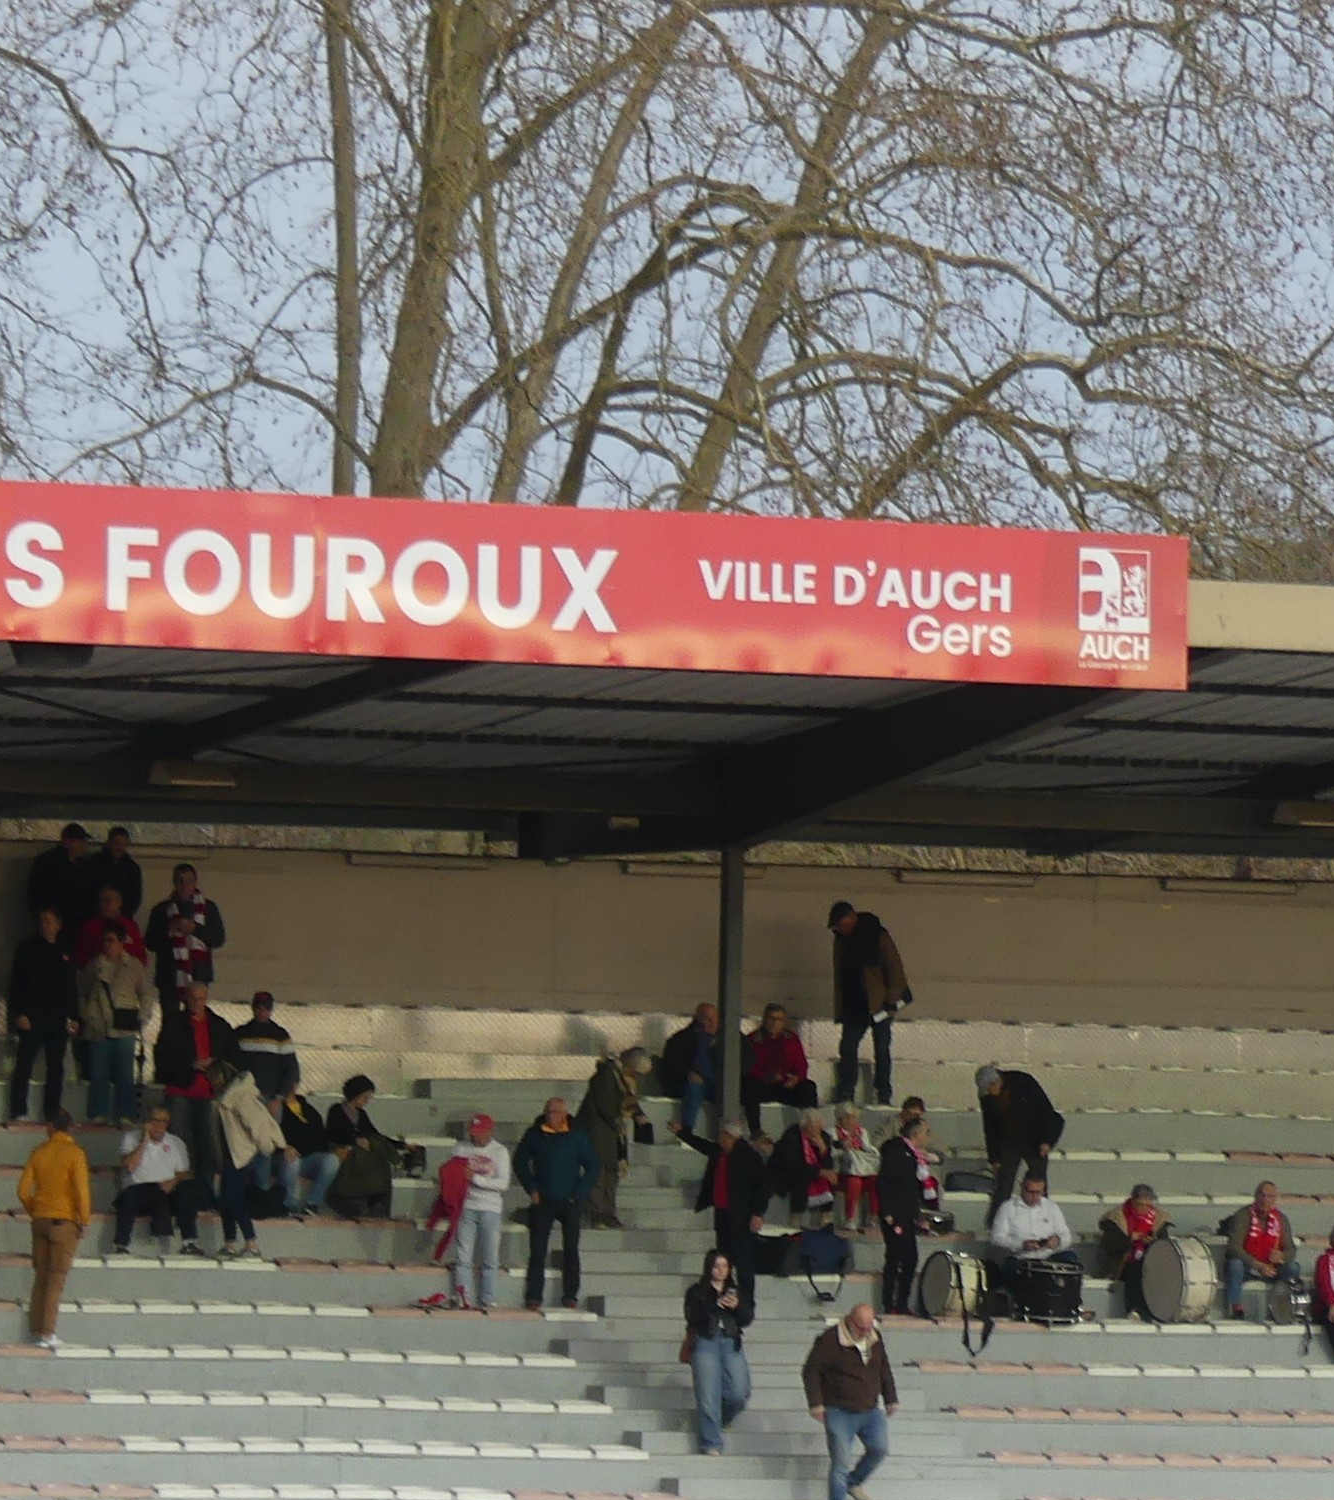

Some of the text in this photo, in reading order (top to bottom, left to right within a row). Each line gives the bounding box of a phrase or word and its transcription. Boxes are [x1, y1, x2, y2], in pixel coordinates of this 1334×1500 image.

[104, 526, 618, 634] FOUROUX
[699, 558, 1012, 614] VILLE D'AUCH
[906, 613, 1012, 659] Gers
[1078, 634, 1151, 662] AUCH
